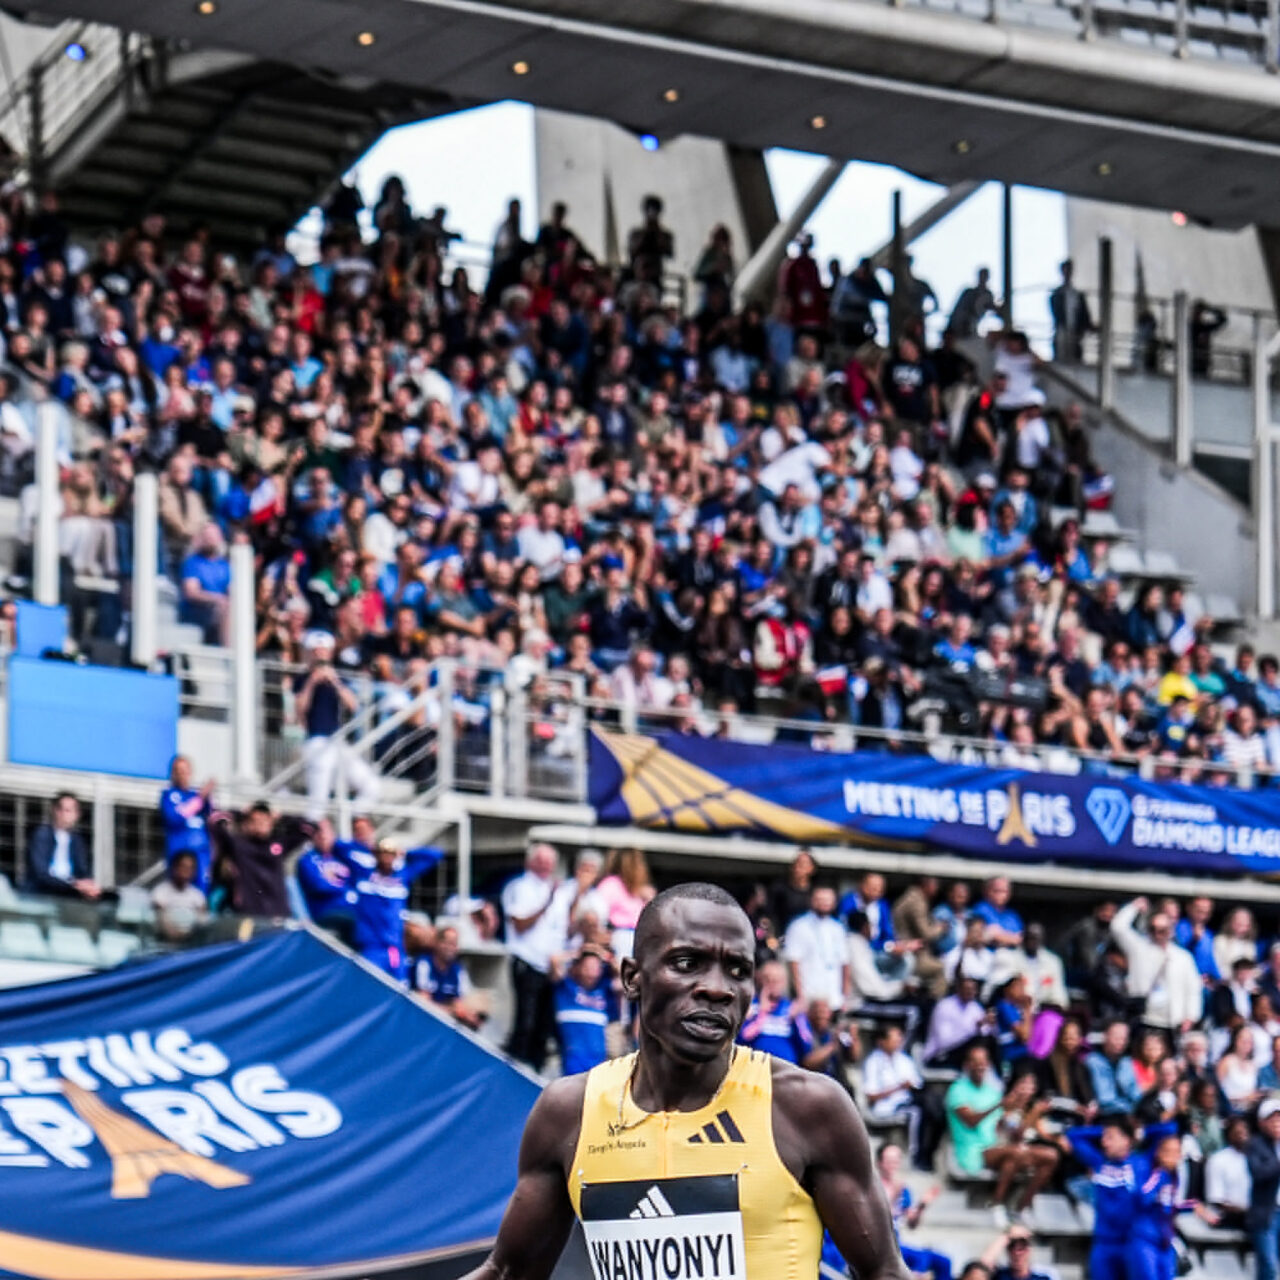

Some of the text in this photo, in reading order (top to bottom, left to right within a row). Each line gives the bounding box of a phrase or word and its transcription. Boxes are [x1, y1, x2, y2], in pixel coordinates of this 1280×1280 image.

[843, 778, 959, 823] MEETING
[986, 787, 1076, 846] PARIS
[1132, 817, 1224, 852] DIAMOND
[0, 1063, 342, 1198] PARIS
